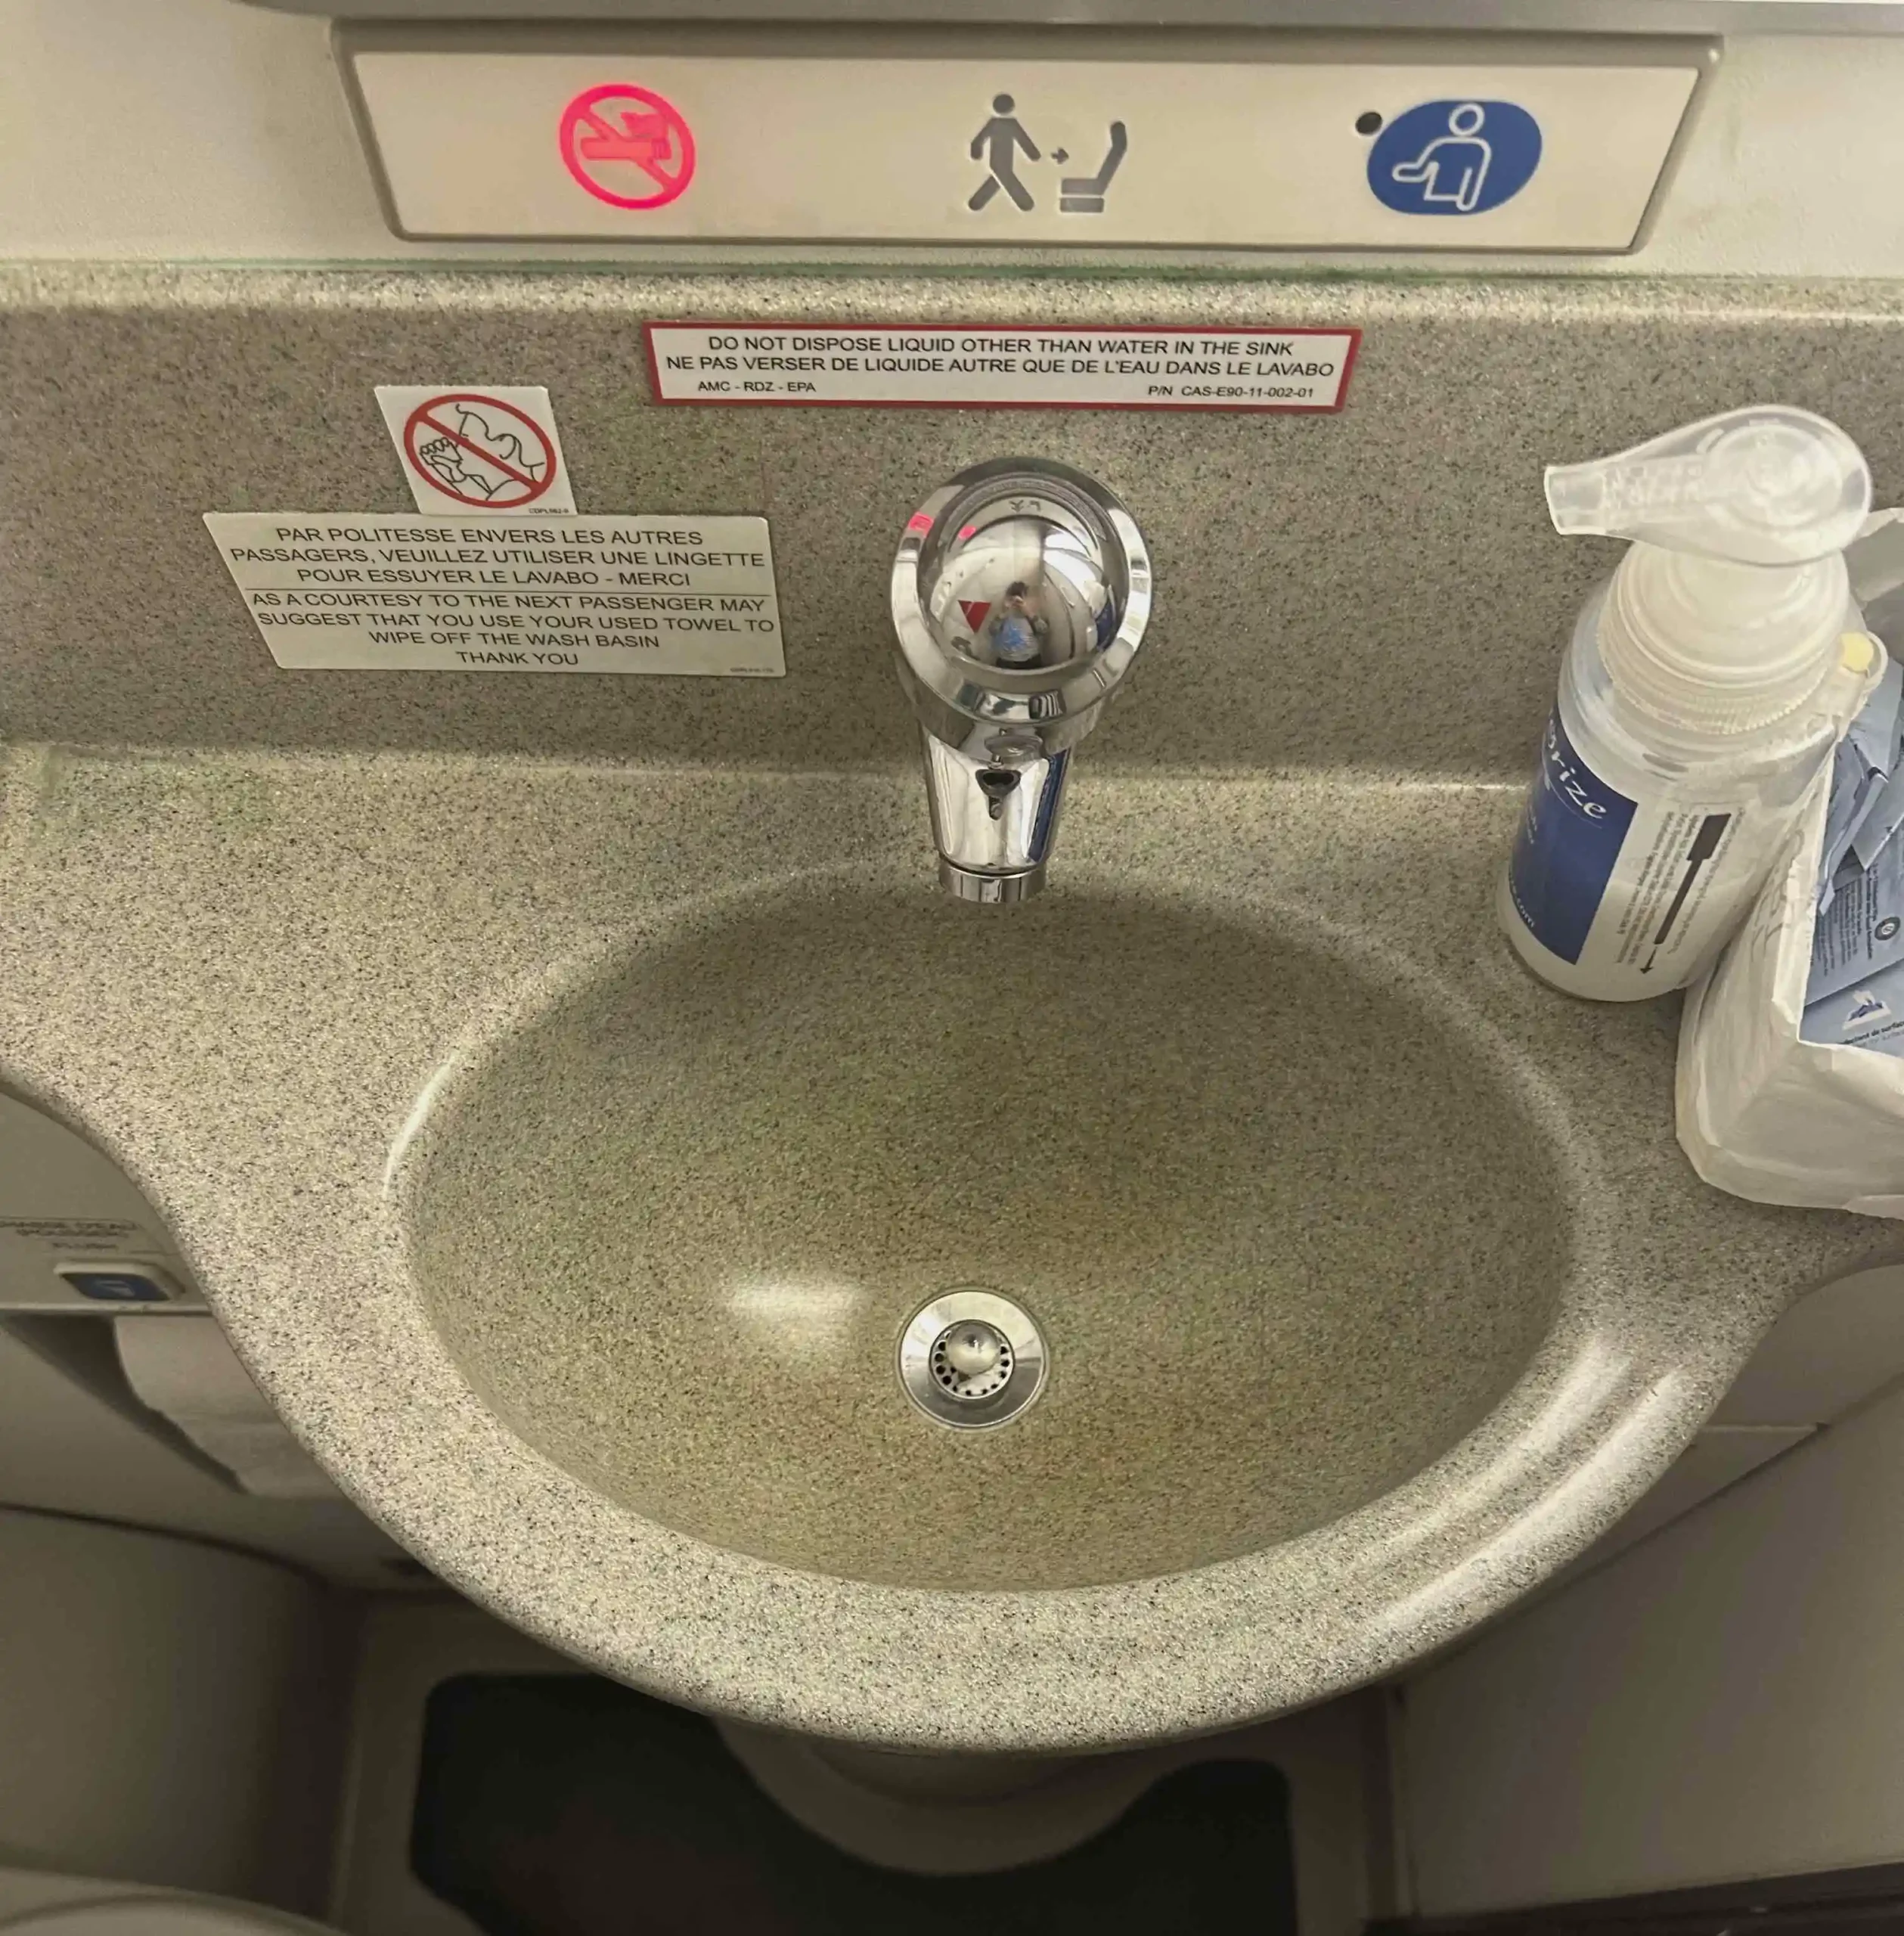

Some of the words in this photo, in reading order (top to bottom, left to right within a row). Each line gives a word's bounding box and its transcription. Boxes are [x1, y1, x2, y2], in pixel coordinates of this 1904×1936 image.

[709, 337, 739, 350] DO
[745, 337, 786, 350] NOT
[792, 337, 882, 351] DISPOSE
[888, 337, 954, 352] LIQUID
[961, 339, 1031, 352] OTHER
[1037, 339, 1092, 353] THAN
[1099, 340, 1168, 354] WATER
[1174, 340, 1194, 354] IN
[1200, 341, 1240, 355] THE
[1245, 342, 1293, 356] SINK
[667, 357, 694, 370] NE
[699, 357, 738, 370] PAS
[743, 357, 826, 371] VERSER
[832, 358, 859, 371] DE
[865, 358, 944, 372] LIQUIDE
[949, 359, 1016, 373] AUTRE
[1022, 359, 1065, 373] QUE
[1071, 360, 1098, 373] DE
[1105, 360, 1159, 374] L'EAU
[1165, 361, 1220, 374] DANS
[1227, 361, 1251, 375] LE
[1257, 362, 1335, 376] LAVABO
[698, 381, 730, 392] AMC
[744, 382, 774, 392] RDZ
[788, 382, 816, 392] EPA
[1148, 386, 1174, 396] P/N
[1181, 386, 1313, 398] CAS-E90-11-002-01
[275, 528, 324, 541] PAR
[329, 529, 456, 542] POLITESSE
[461, 529, 556, 544] ENVERS
[562, 530, 605, 544] LES
[611, 531, 702, 544] AUTRES
[231, 548, 376, 563] PASSAGERS,
[378, 550, 488, 563] VEUILLEZ
[492, 551, 595, 564] UTILISER
[601, 552, 648, 565] UNE
[655, 552, 765, 566] LINGETTE
[297, 569, 364, 582] POUR
[368, 569, 475, 583] ESSUYER
[479, 571, 507, 583] LE
[513, 571, 599, 584] LAVABO
[619, 572, 690, 586] MERCI
[253, 593, 281, 605] AS
[287, 594, 302, 605] A
[305, 594, 422, 606] COURTESY
[428, 594, 460, 607] TO
[464, 595, 510, 607] THE
[515, 596, 572, 609] NEXT
[580, 597, 715, 611] PASSENGER
[721, 599, 764, 612] MAY
[258, 613, 361, 625] SUGGEST
[367, 614, 420, 625] THAT
[426, 615, 473, 626] YOU
[480, 615, 525, 627] USE
[529, 616, 594, 629] YOUR
[599, 617, 658, 629] USED
[663, 618, 741, 631] TOWEL
[745, 619, 774, 632] TO
[369, 631, 426, 644] WIPE
[430, 632, 471, 644] OFF
[477, 633, 522, 645] THE
[526, 634, 589, 646] WASH
[596, 635, 659, 647] BASIN
[456, 651, 529, 664] THANK
[532, 653, 578, 666] YOU
